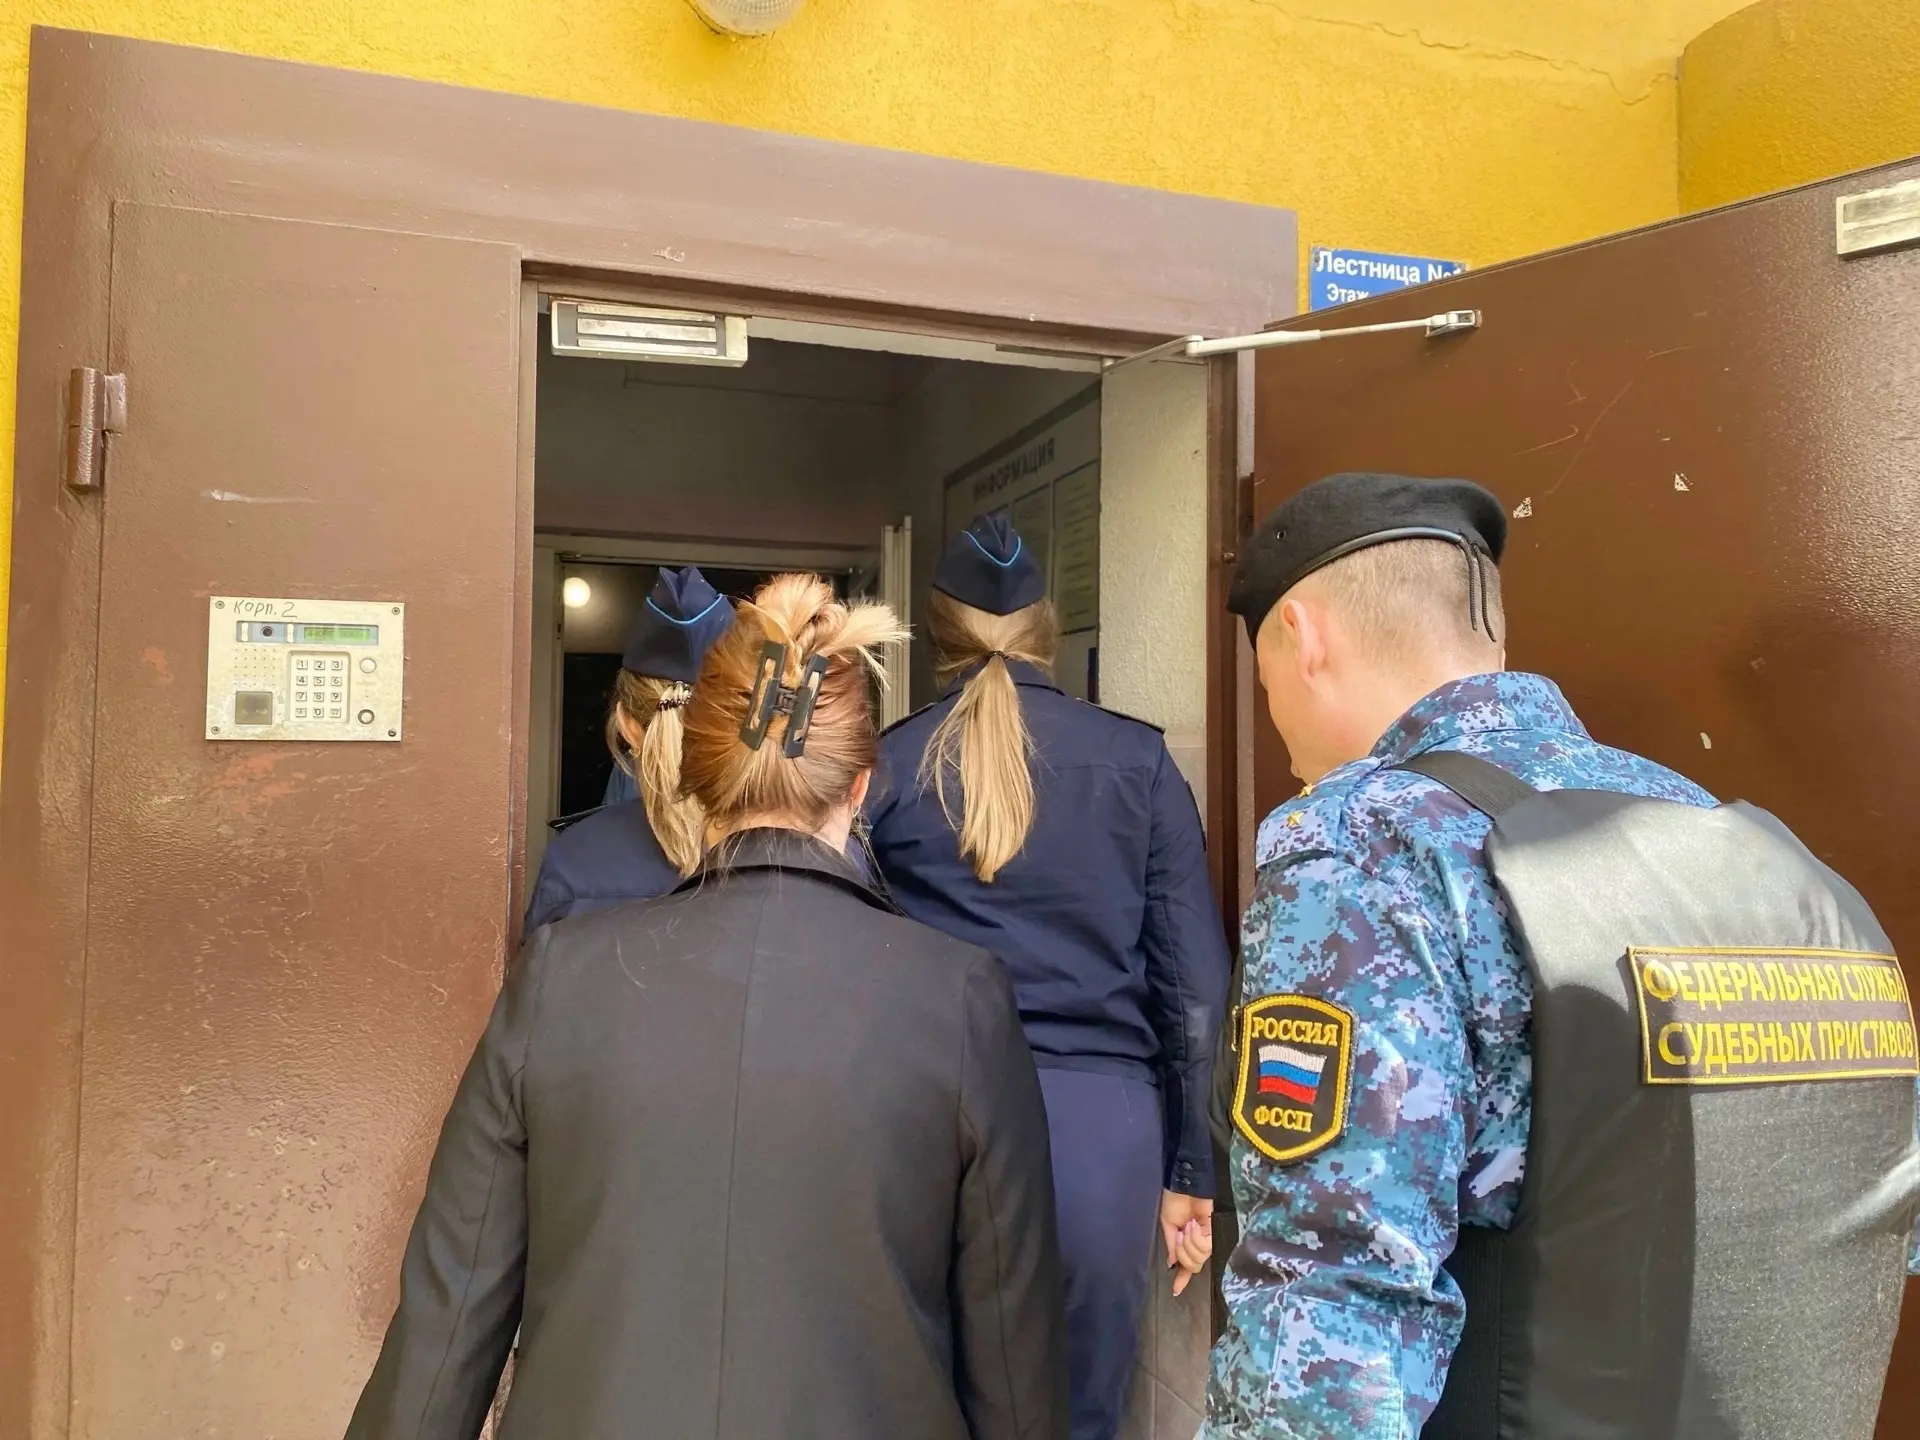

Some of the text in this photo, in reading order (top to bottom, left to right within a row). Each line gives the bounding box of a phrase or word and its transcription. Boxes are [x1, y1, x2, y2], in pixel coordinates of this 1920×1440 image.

[1316, 251, 1421, 285] Лестница
[1326, 283, 1370, 303] Этаж
[973, 437, 1055, 503] ИНФОРМАЦИЯ
[281, 601, 298, 618] 2
[1642, 959, 1907, 1011] ФЕДЕРАЛЬНАЯ СЛУЖБА
[1251, 1016, 1339, 1047] РОССИЯ
[1658, 1020, 1914, 1075] СУДЕБНЫХ ПРИСТАВОВ
[1254, 1105, 1314, 1132] ФССП
